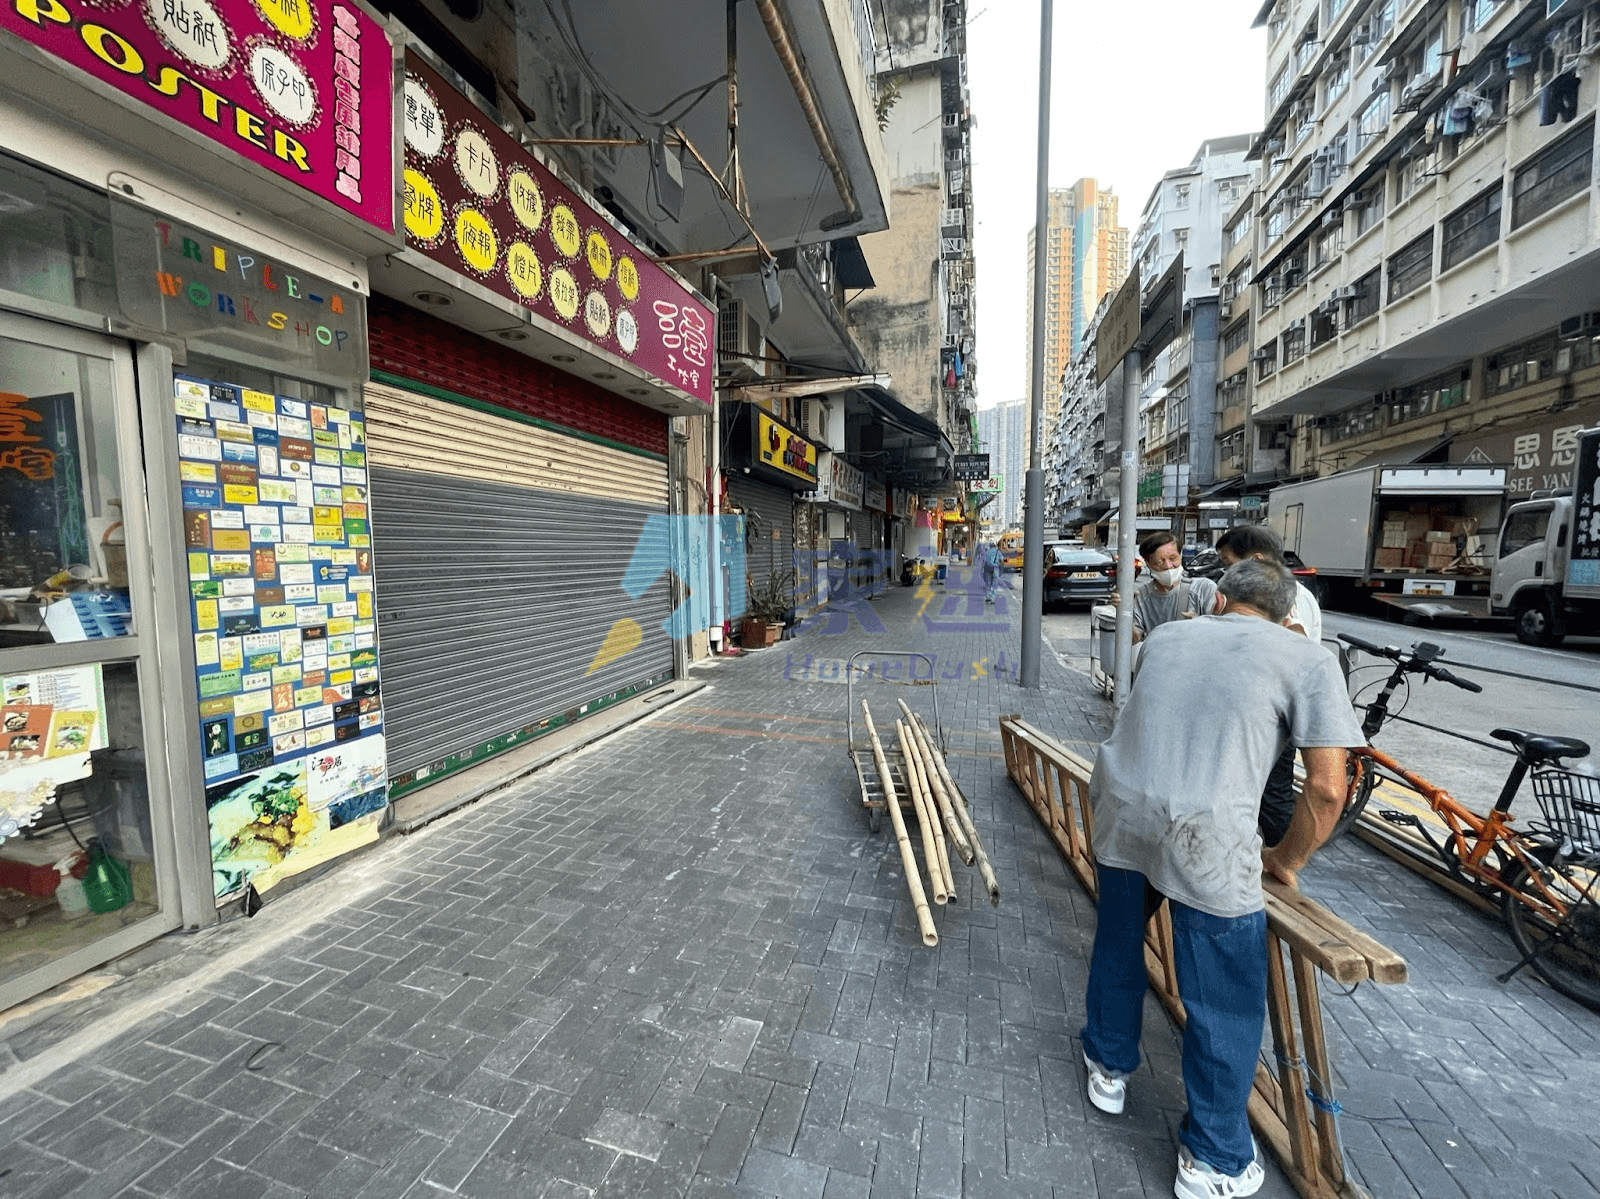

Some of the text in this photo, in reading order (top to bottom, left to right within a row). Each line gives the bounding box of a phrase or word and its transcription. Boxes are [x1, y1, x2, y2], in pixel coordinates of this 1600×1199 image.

[16, 0, 312, 172] POSTER
[261, 57, 306, 110] 原子印
[463, 142, 492, 185] 卡片
[462, 219, 493, 261] 海報
[513, 252, 538, 287] 燈片
[1512, 424, 1584, 471] 思恩
[1509, 472, 1571, 493] SEE YAN
